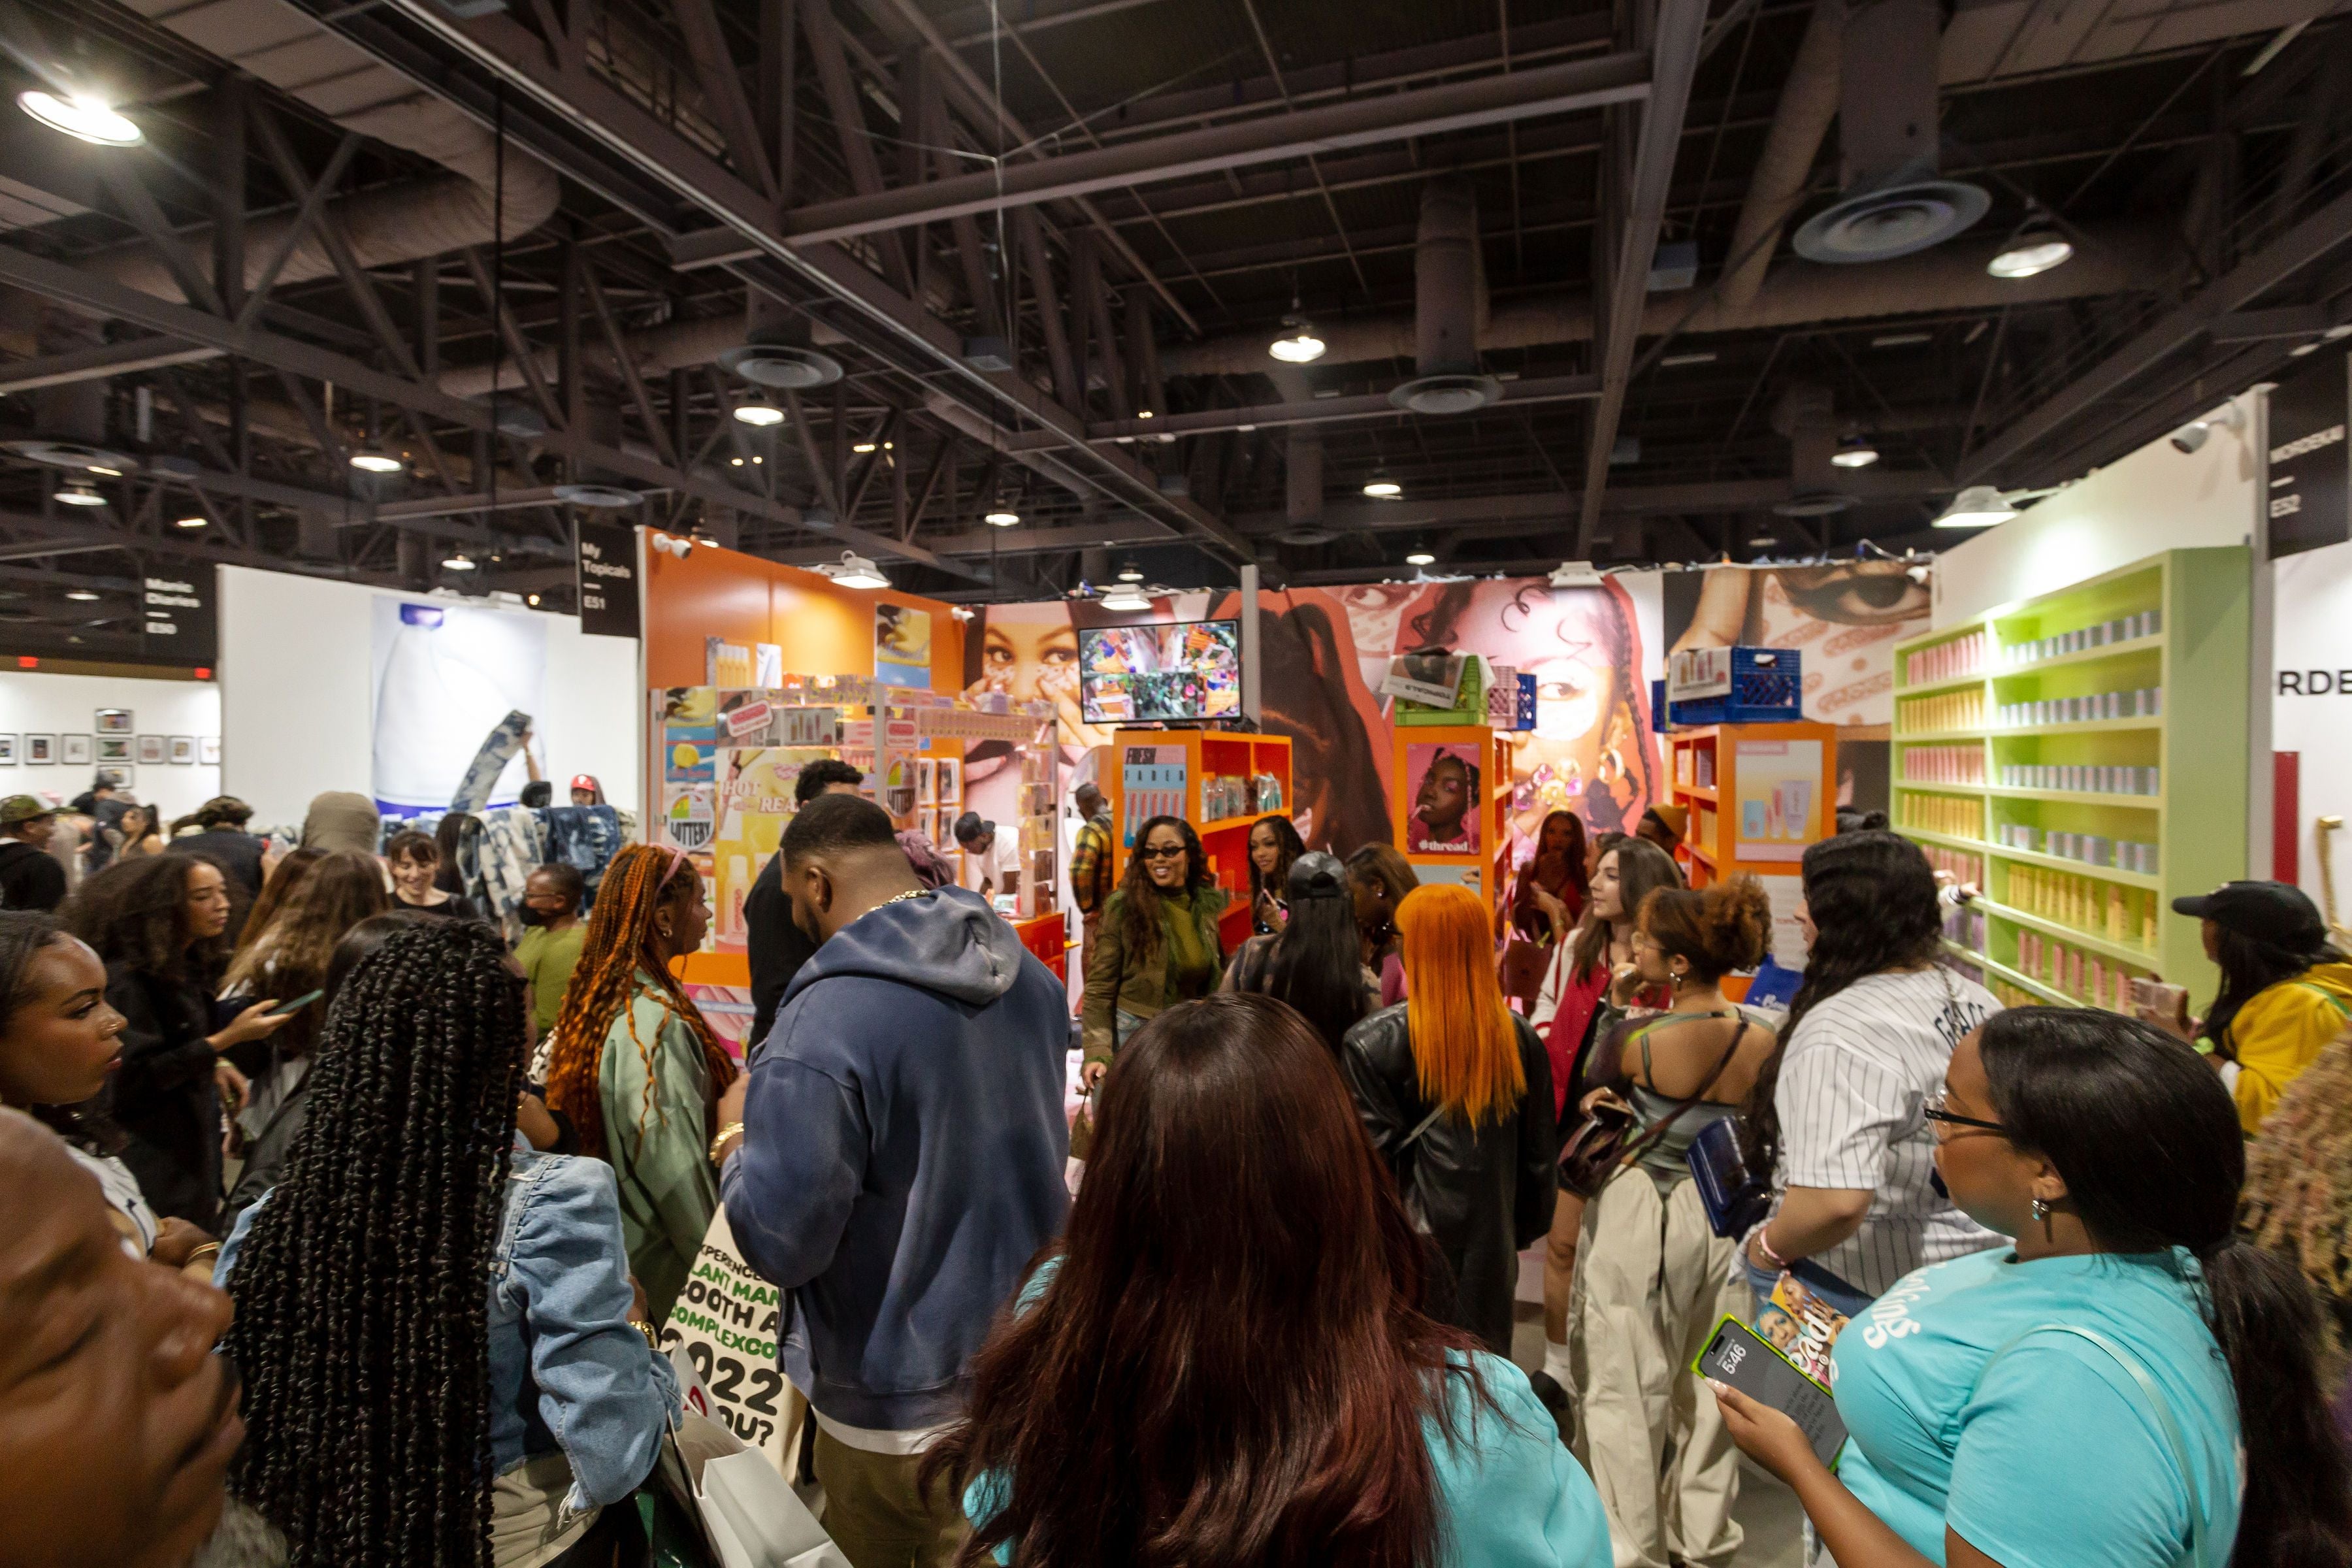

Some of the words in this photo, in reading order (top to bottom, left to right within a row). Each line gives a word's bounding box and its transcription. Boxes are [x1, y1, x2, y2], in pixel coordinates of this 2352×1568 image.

[581, 559, 631, 579] Topicals
[1126, 747, 1156, 764] FRESH
[670, 821, 710, 847] LOTTERY
[681, 1279, 754, 1329] OOTH
[1722, 1344, 1746, 1375] 5:46
